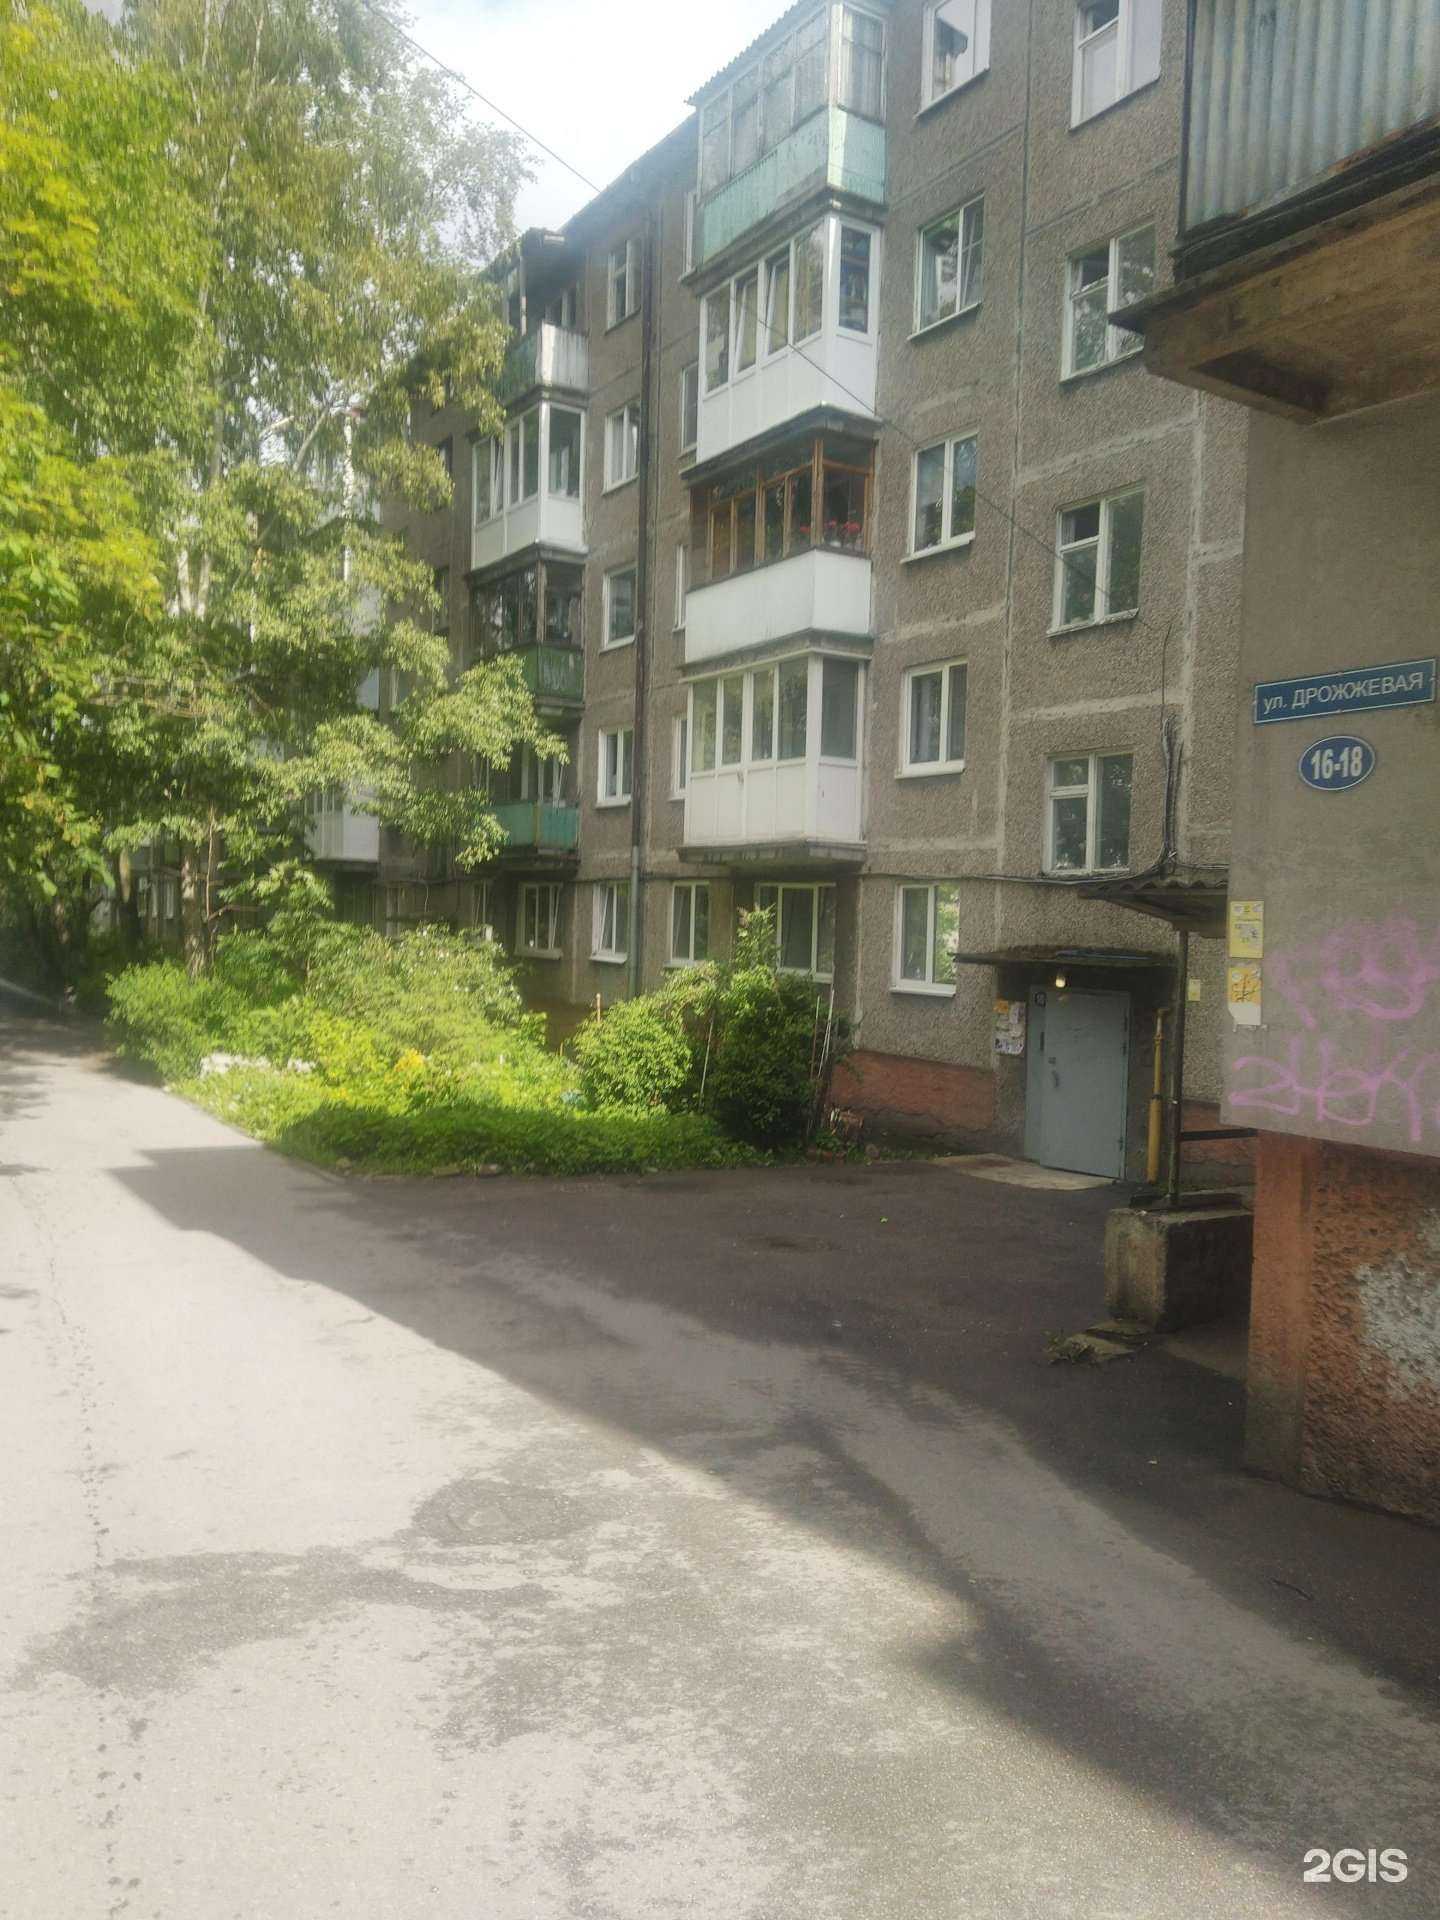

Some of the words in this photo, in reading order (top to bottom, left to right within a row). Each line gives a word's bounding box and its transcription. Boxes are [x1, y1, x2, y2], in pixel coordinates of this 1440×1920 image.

[1263, 695, 1288, 714] ул.
[1292, 672, 1424, 709] ДРОЖЖЕВАЯ
[1311, 746, 1362, 780] 16-18
